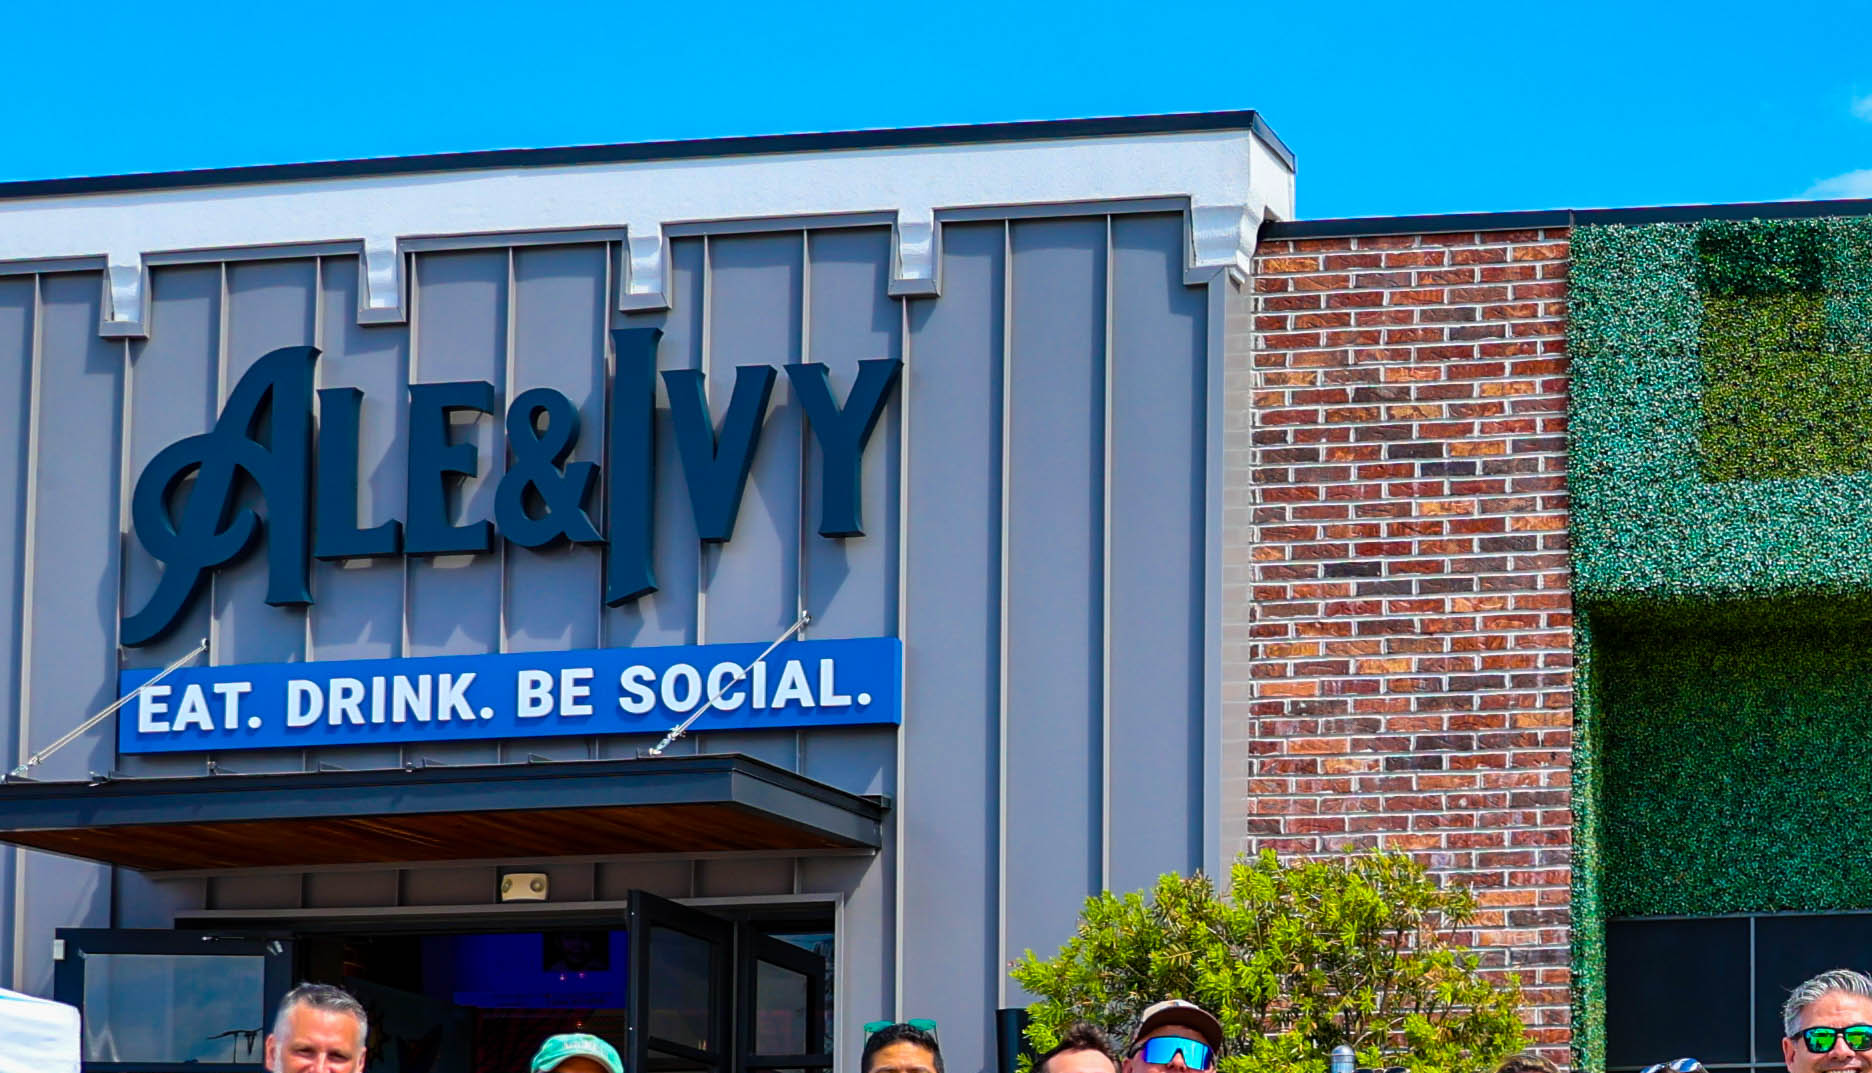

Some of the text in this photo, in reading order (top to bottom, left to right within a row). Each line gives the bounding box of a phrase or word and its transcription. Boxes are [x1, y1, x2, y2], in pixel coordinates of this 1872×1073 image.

[138, 658, 873, 734] EAT. DRINK. BE SOCIAL.
